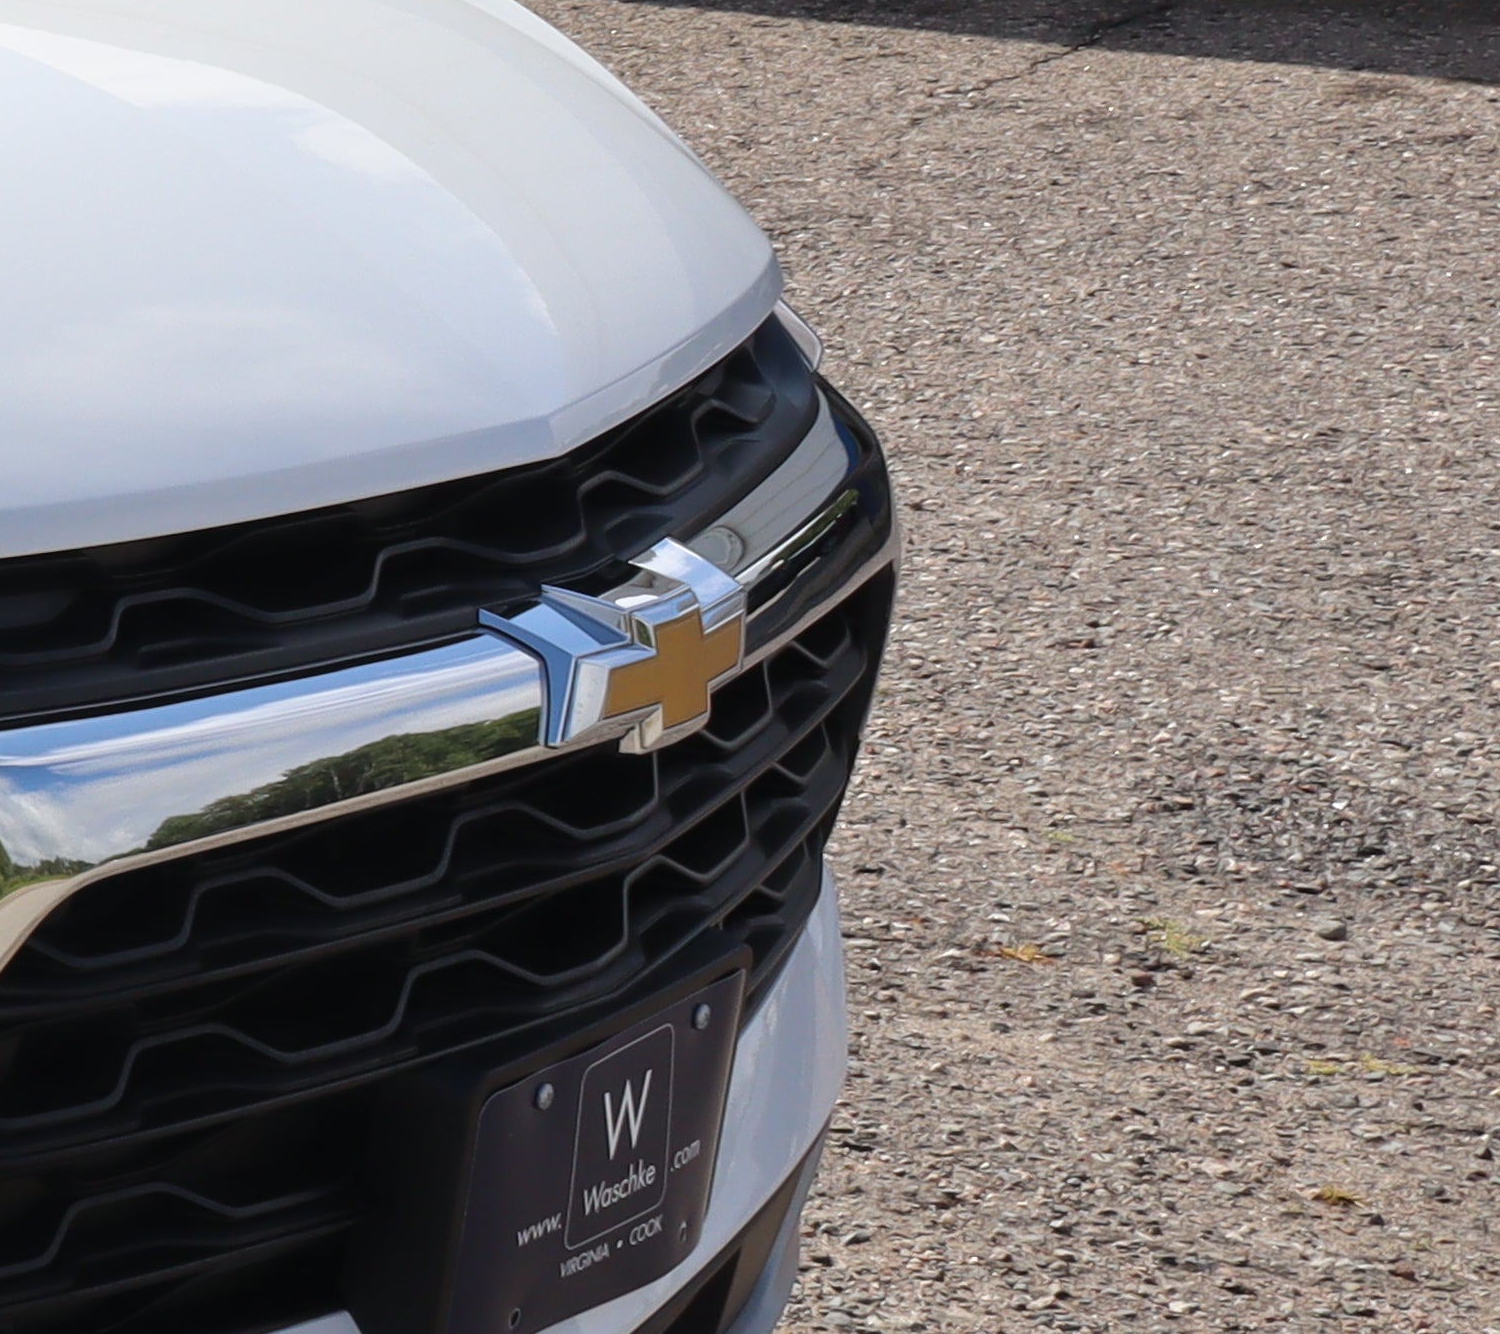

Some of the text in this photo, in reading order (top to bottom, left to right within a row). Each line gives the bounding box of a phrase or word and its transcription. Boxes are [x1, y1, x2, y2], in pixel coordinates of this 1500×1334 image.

[603, 1069, 653, 1161] W
[582, 1159, 657, 1218] Waschke
[669, 1137, 702, 1174] .com
[559, 1212, 664, 1279] VIRGINIA COOK
